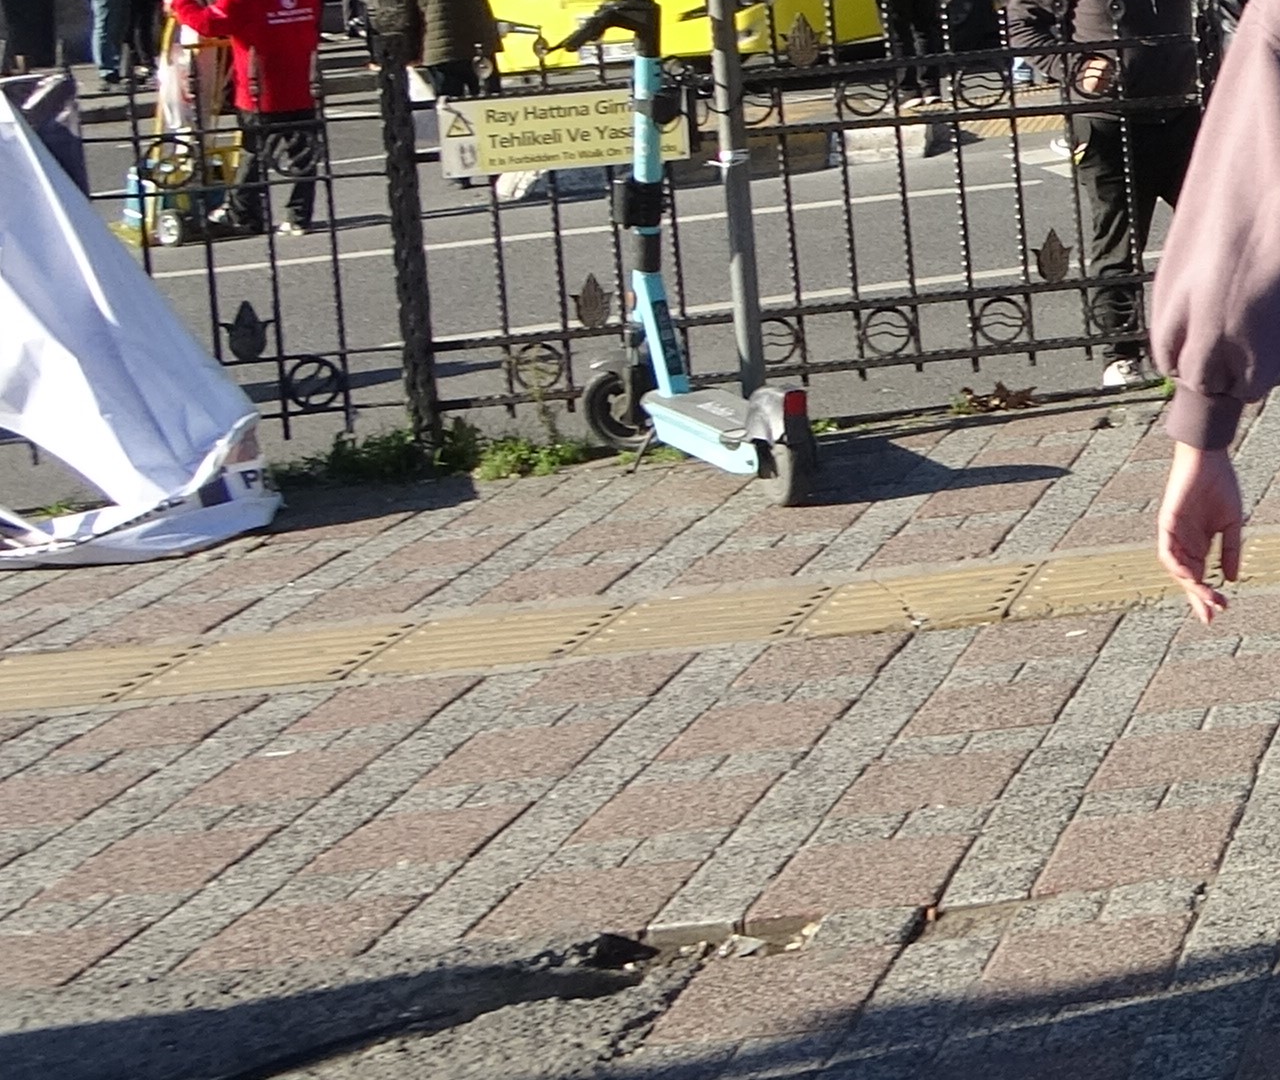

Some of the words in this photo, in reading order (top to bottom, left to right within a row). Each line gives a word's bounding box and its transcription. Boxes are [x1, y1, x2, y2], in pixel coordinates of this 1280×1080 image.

[485, 108, 520, 127] Ray
[487, 128, 562, 149] Tehlikeli
[566, 126, 591, 142] Ve
